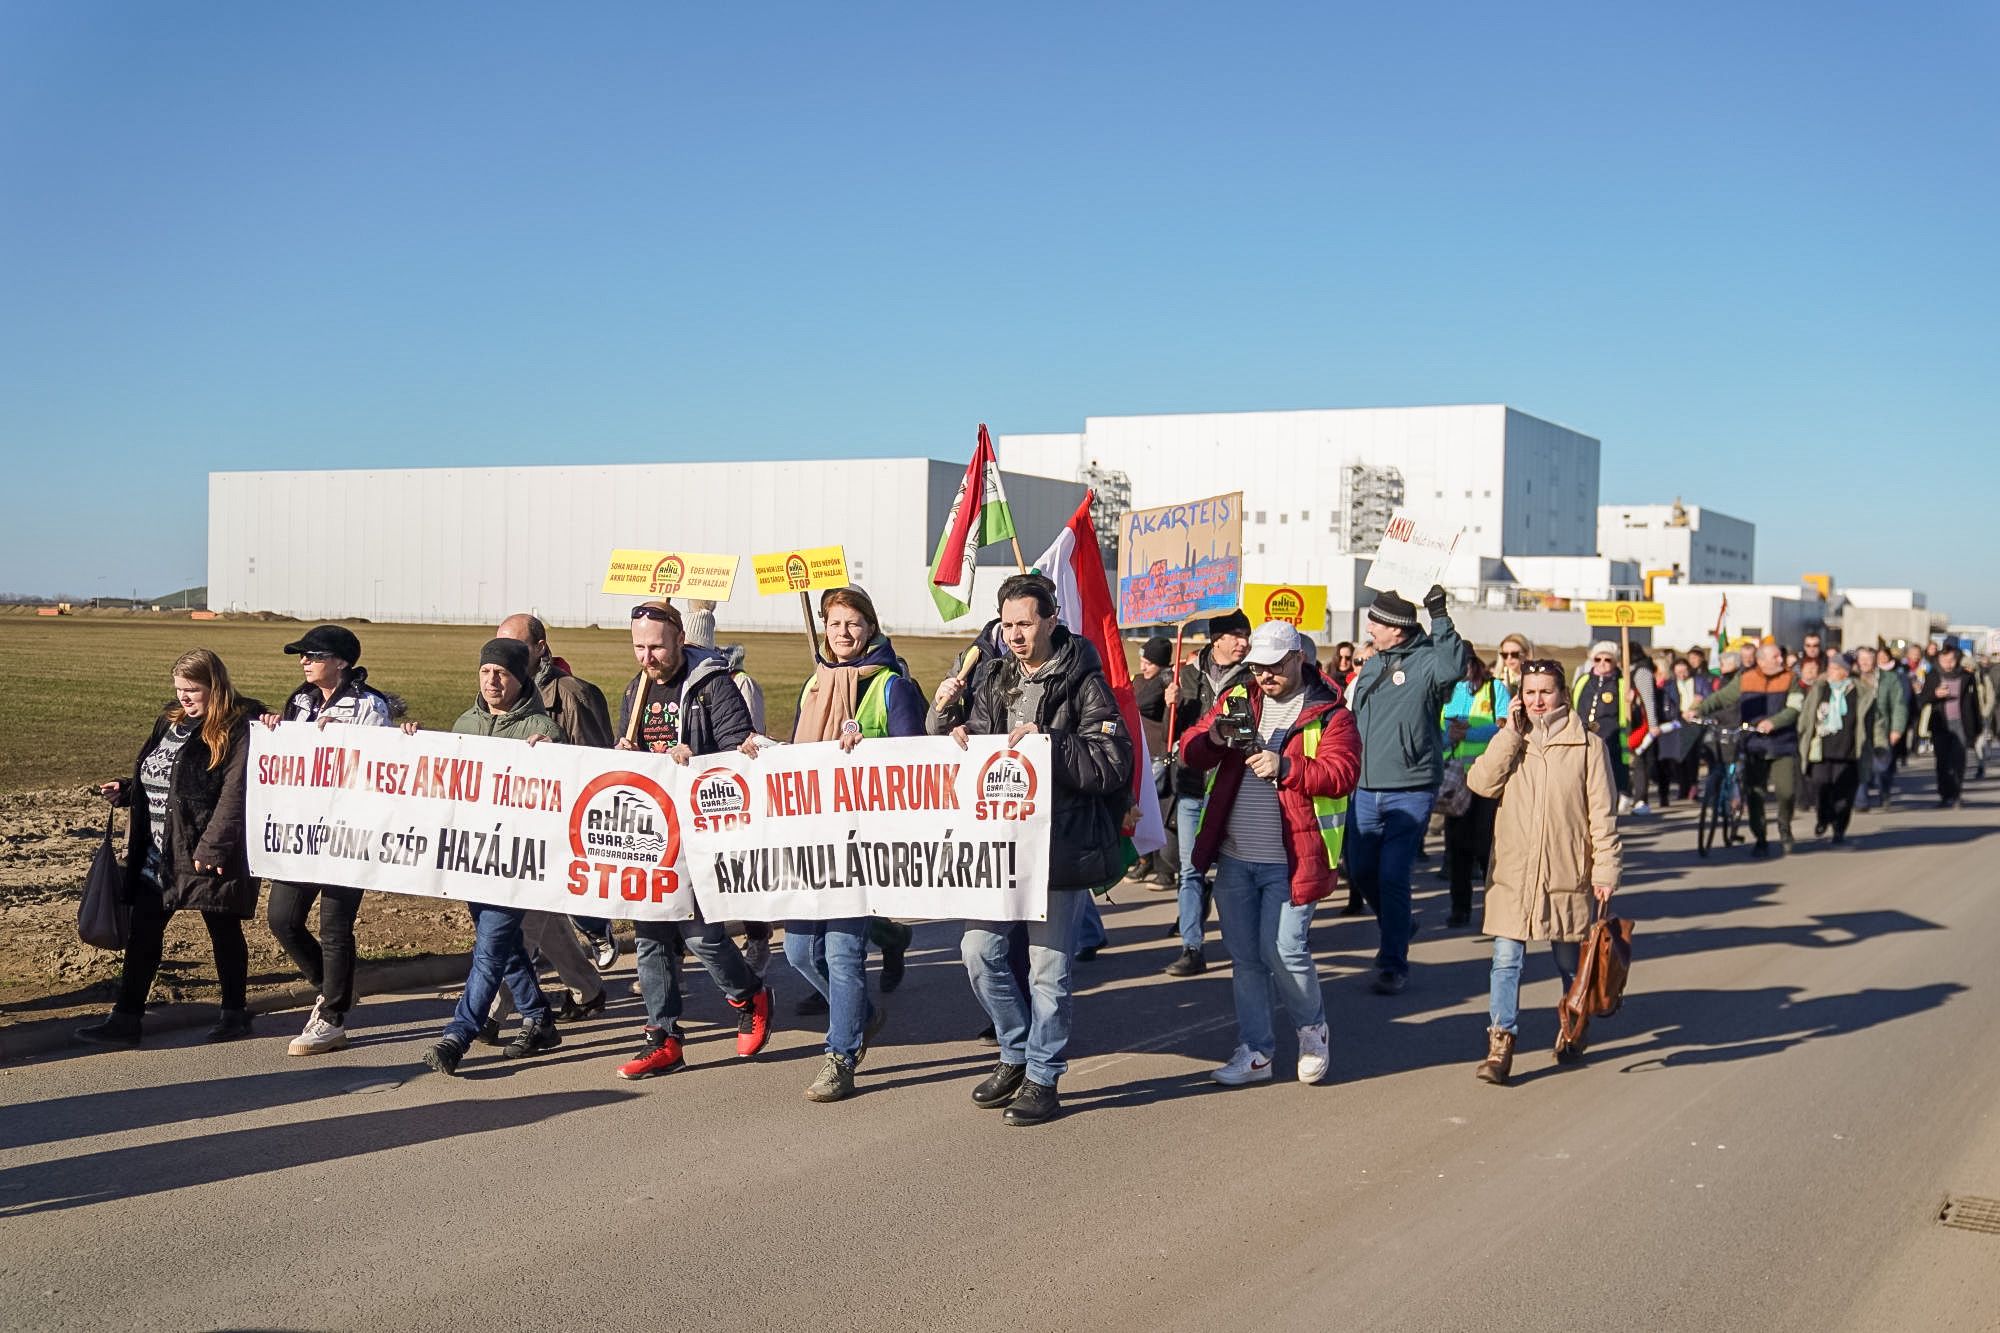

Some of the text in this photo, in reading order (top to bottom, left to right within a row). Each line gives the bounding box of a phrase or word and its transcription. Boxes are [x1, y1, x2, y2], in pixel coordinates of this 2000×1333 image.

[649, 582, 681, 594] STOP
[788, 579, 810, 590] STOP
[1264, 617, 1303, 627] OP
[259, 747, 562, 813] SOHA NEM LESZ AKKU TÁRGYA
[987, 763, 1021, 784] AKKU
[699, 781, 737, 801] AKKU
[766, 763, 961, 818] NEM AKARUNK
[587, 796, 655, 836] AKKU
[975, 801, 1036, 821] STOP
[694, 812, 751, 833] STOP
[264, 814, 546, 881] ÉDES NÉPÜNK SZÉP HAZÁJA!
[588, 831, 622, 848] GYÁR
[714, 829, 1017, 894] AKKUMULÁTORGYÁRAT!
[567, 859, 679, 903] STOP
